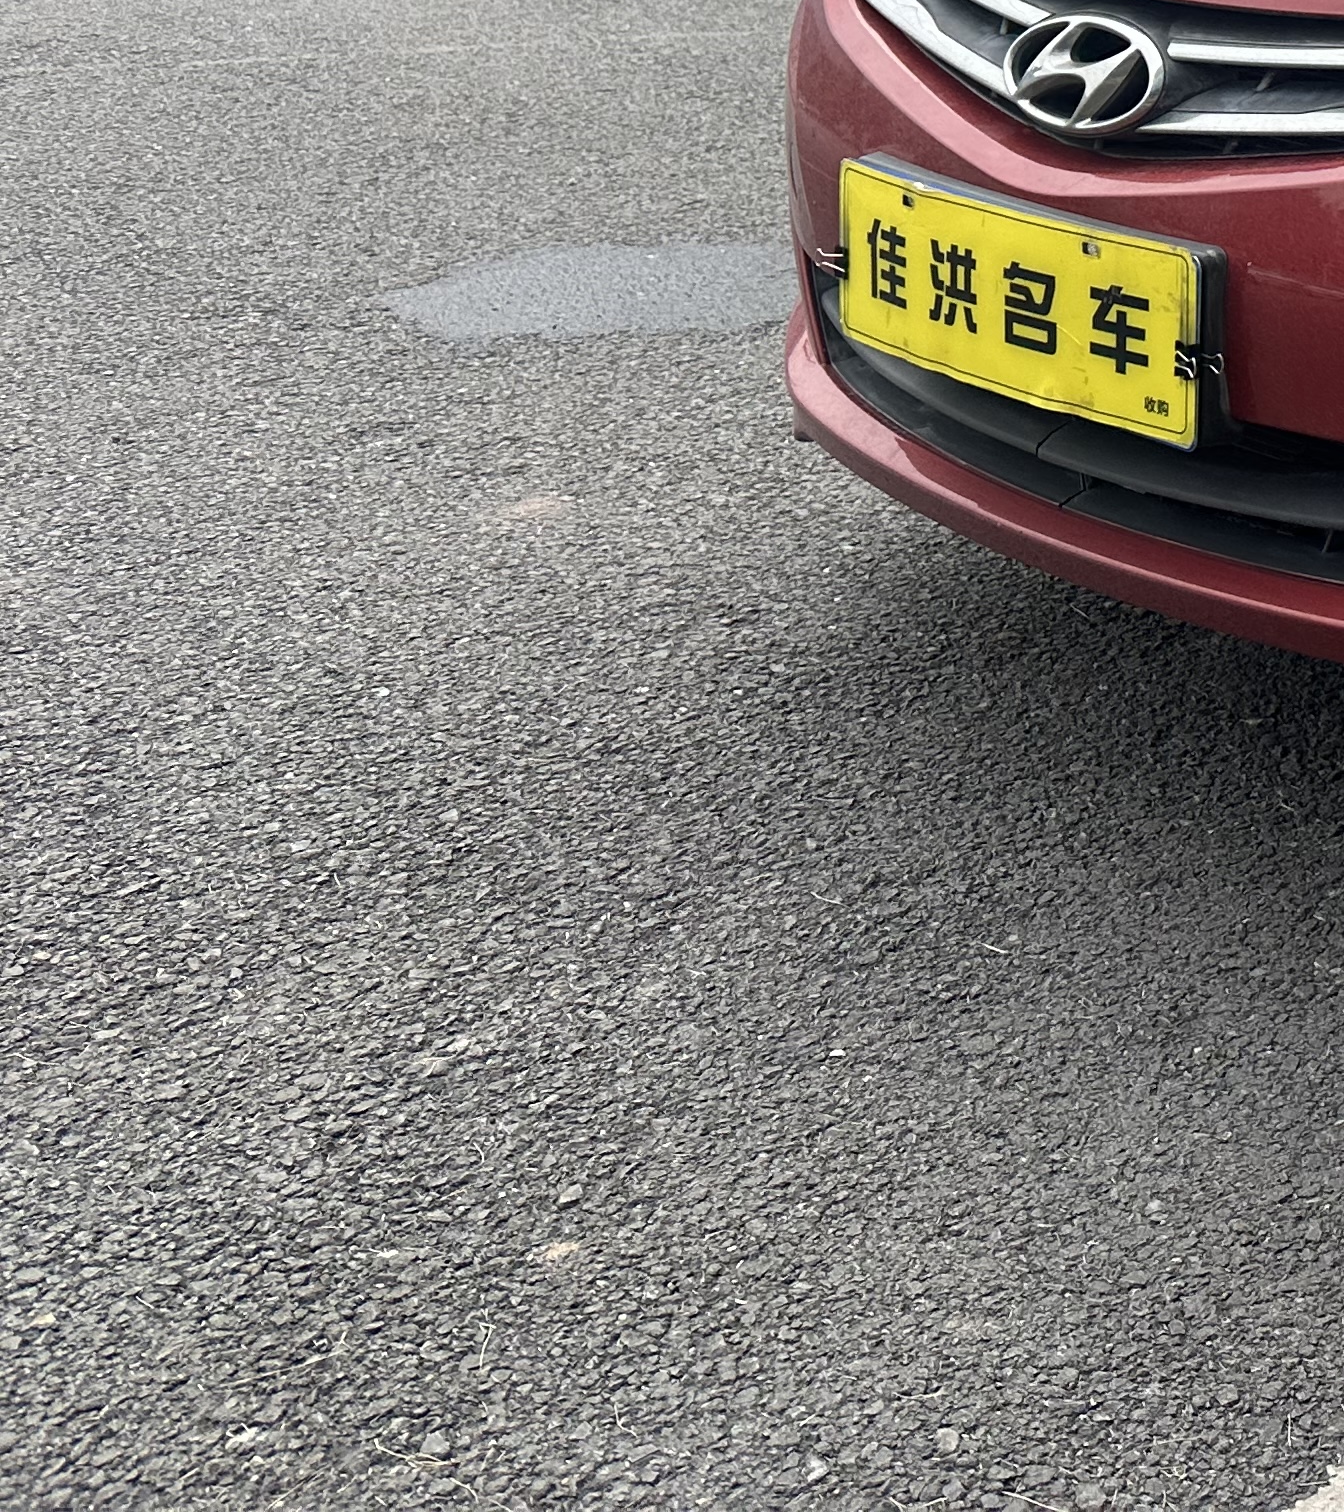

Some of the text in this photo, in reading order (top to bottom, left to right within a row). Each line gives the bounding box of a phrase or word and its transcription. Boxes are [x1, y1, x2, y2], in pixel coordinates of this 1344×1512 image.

[866, 218, 1150, 376] 佳洪名车
[1143, 396, 1169, 417] 收购
